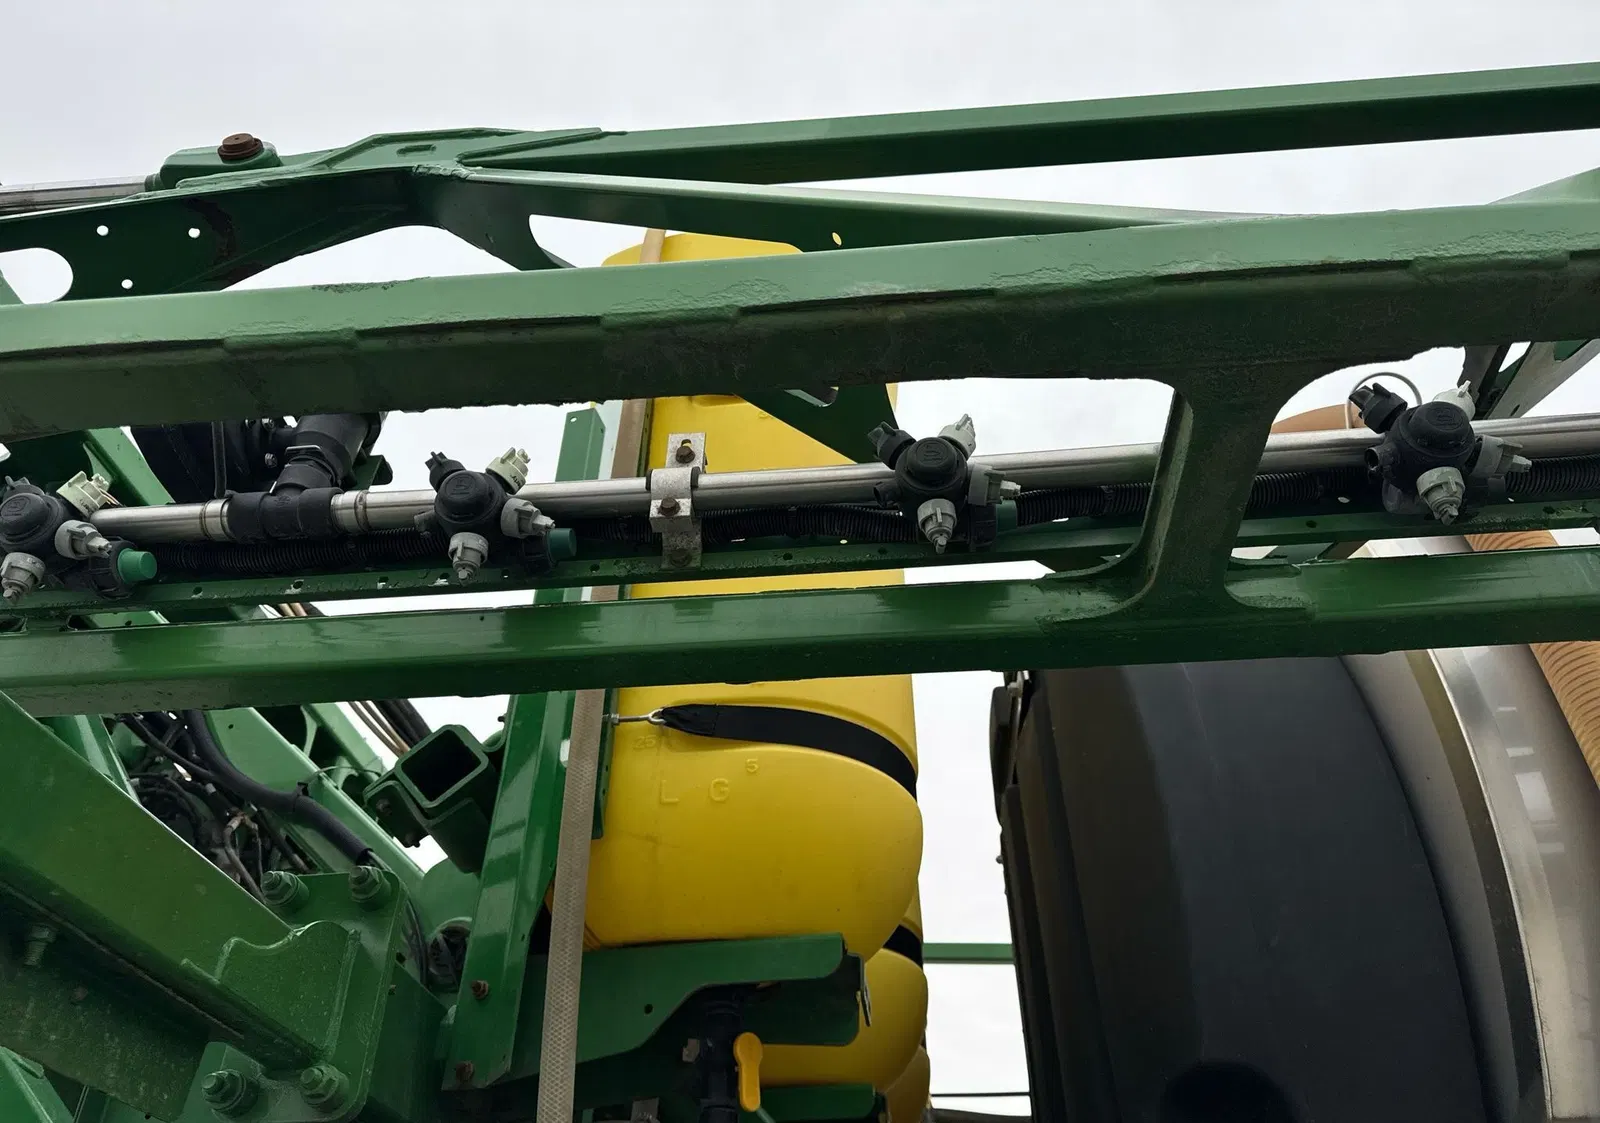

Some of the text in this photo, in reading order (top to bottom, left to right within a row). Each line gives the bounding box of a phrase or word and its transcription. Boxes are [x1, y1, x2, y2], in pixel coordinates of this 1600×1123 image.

[745, 757, 760, 773] 5
[661, 777, 730, 803] L G
